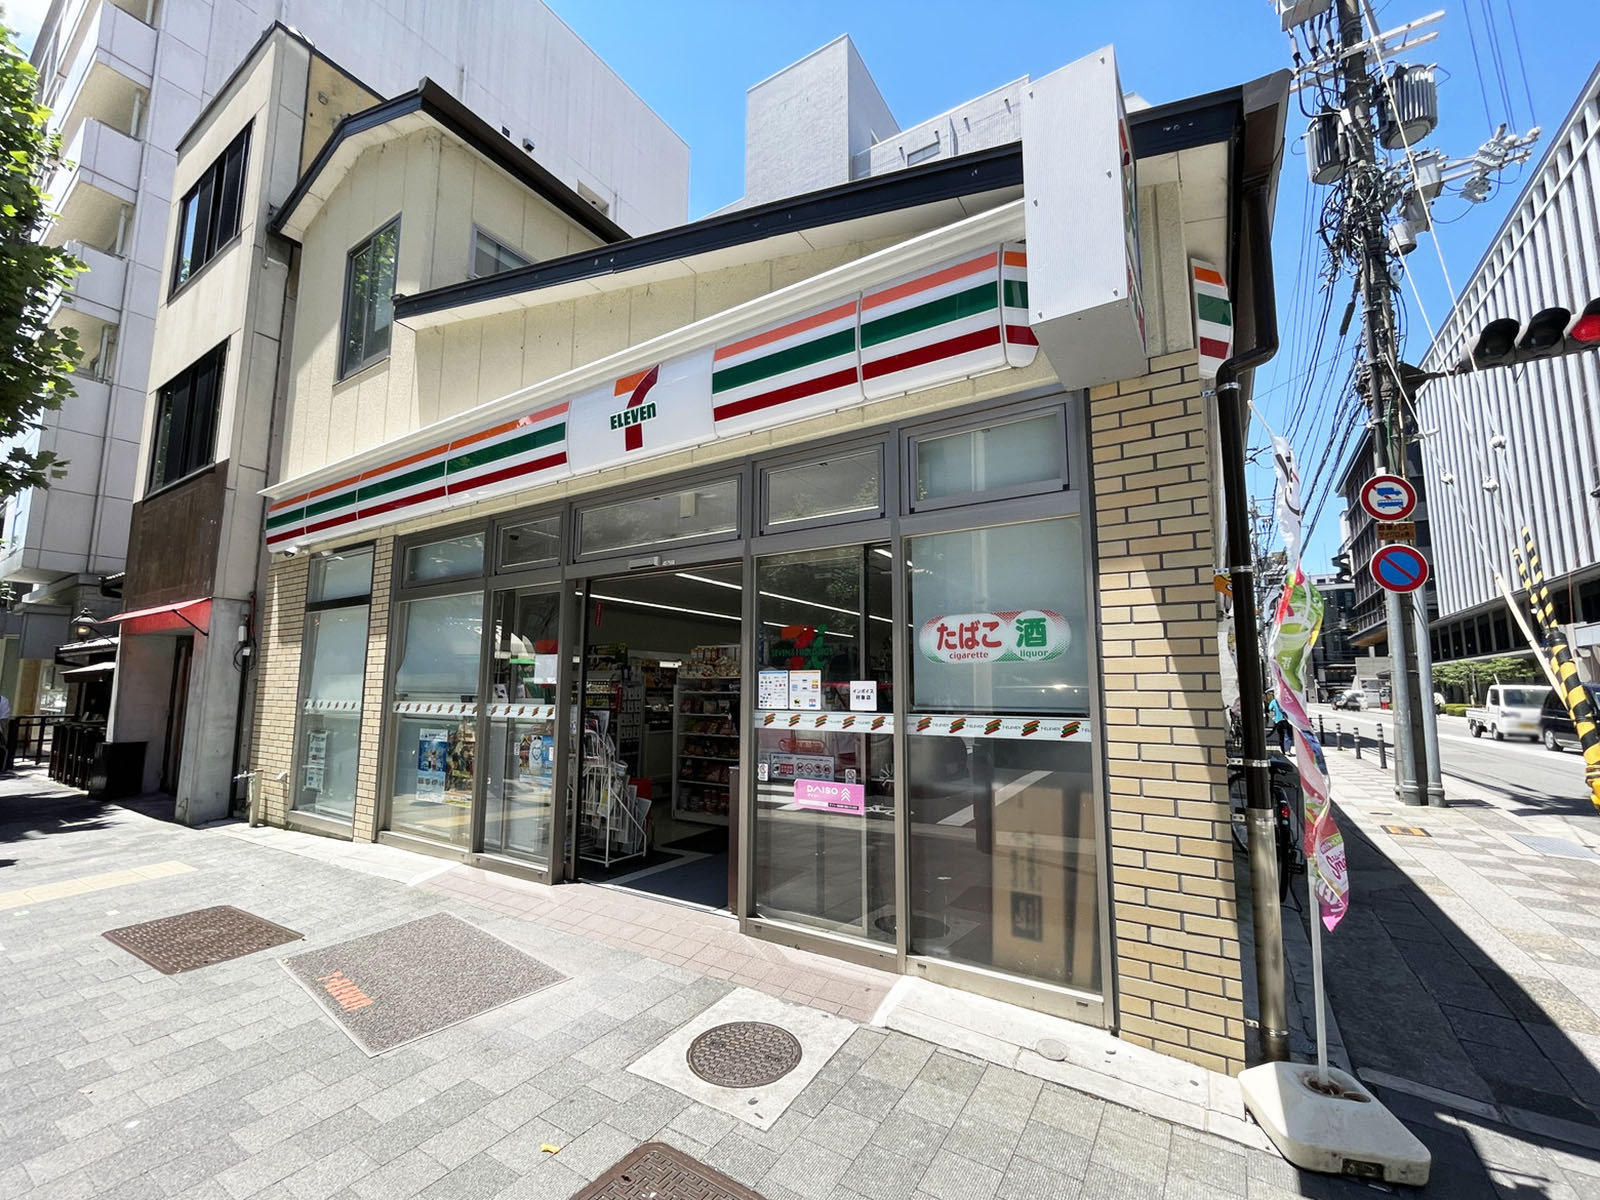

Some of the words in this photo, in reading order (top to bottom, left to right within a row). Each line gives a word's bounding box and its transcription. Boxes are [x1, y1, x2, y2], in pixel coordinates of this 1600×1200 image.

[614, 364, 659, 452] 7
[936, 620, 1002, 650] たばこ
[1015, 617, 1047, 648] 酒
[949, 651, 989, 660] cigarette
[1020, 649, 1049, 658] liquor
[806, 784, 839, 795] DAISO
